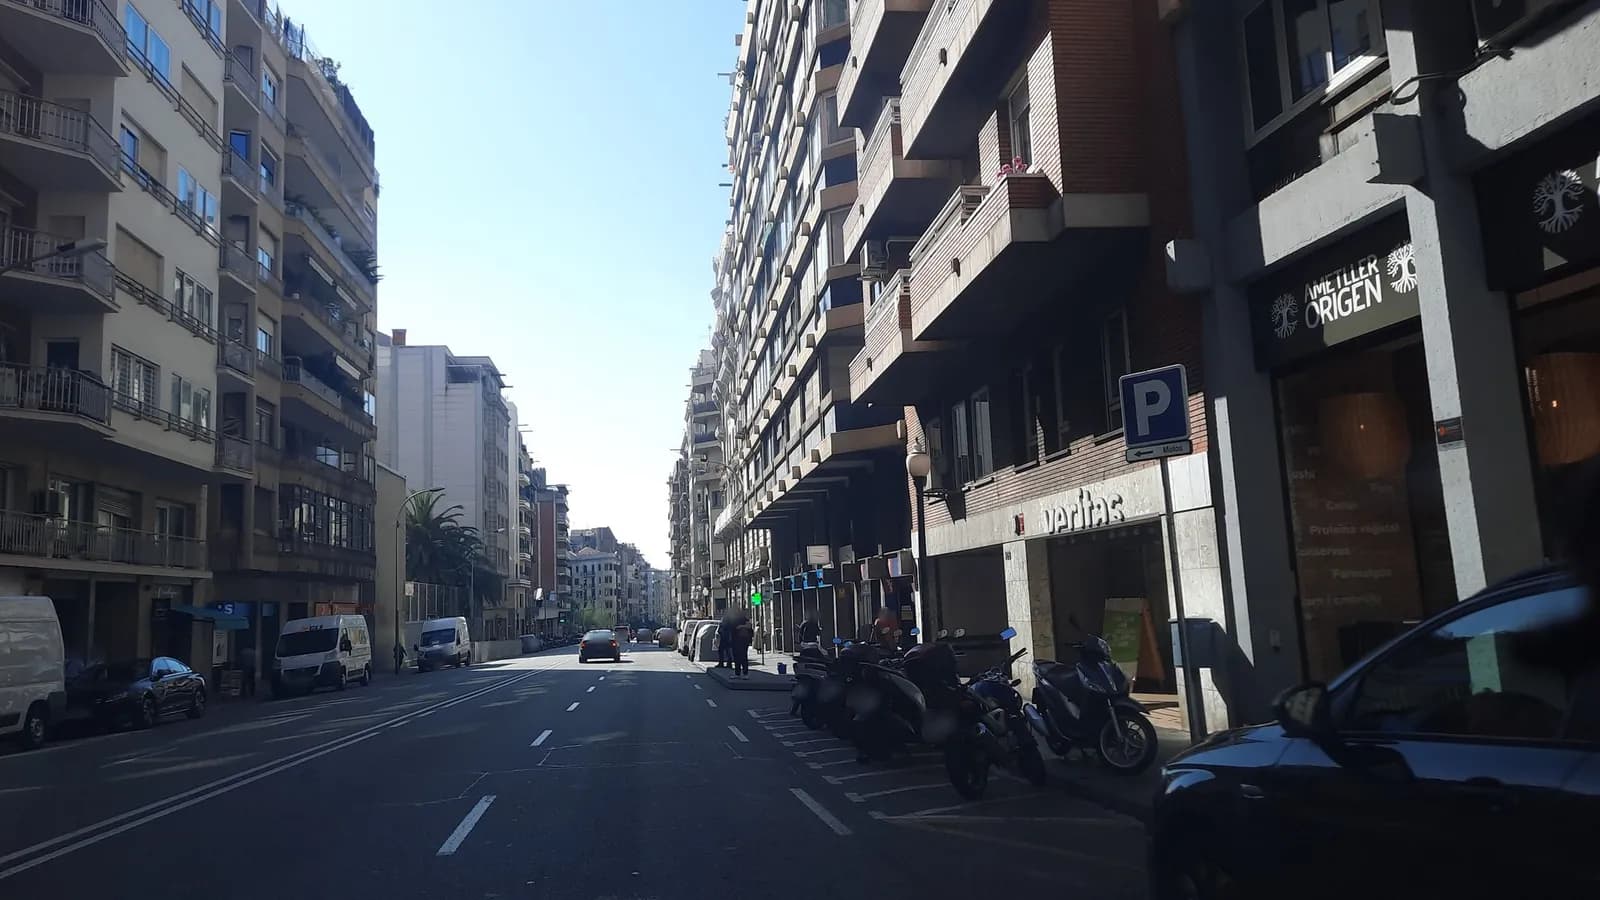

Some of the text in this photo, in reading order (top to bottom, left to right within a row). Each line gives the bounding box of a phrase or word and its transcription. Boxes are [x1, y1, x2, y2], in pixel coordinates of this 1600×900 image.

[1304, 254, 1380, 303] AMETLLER
[1304, 274, 1383, 329] ORIGEN
[1133, 379, 1171, 437] P
[1044, 488, 1125, 535] veritas
